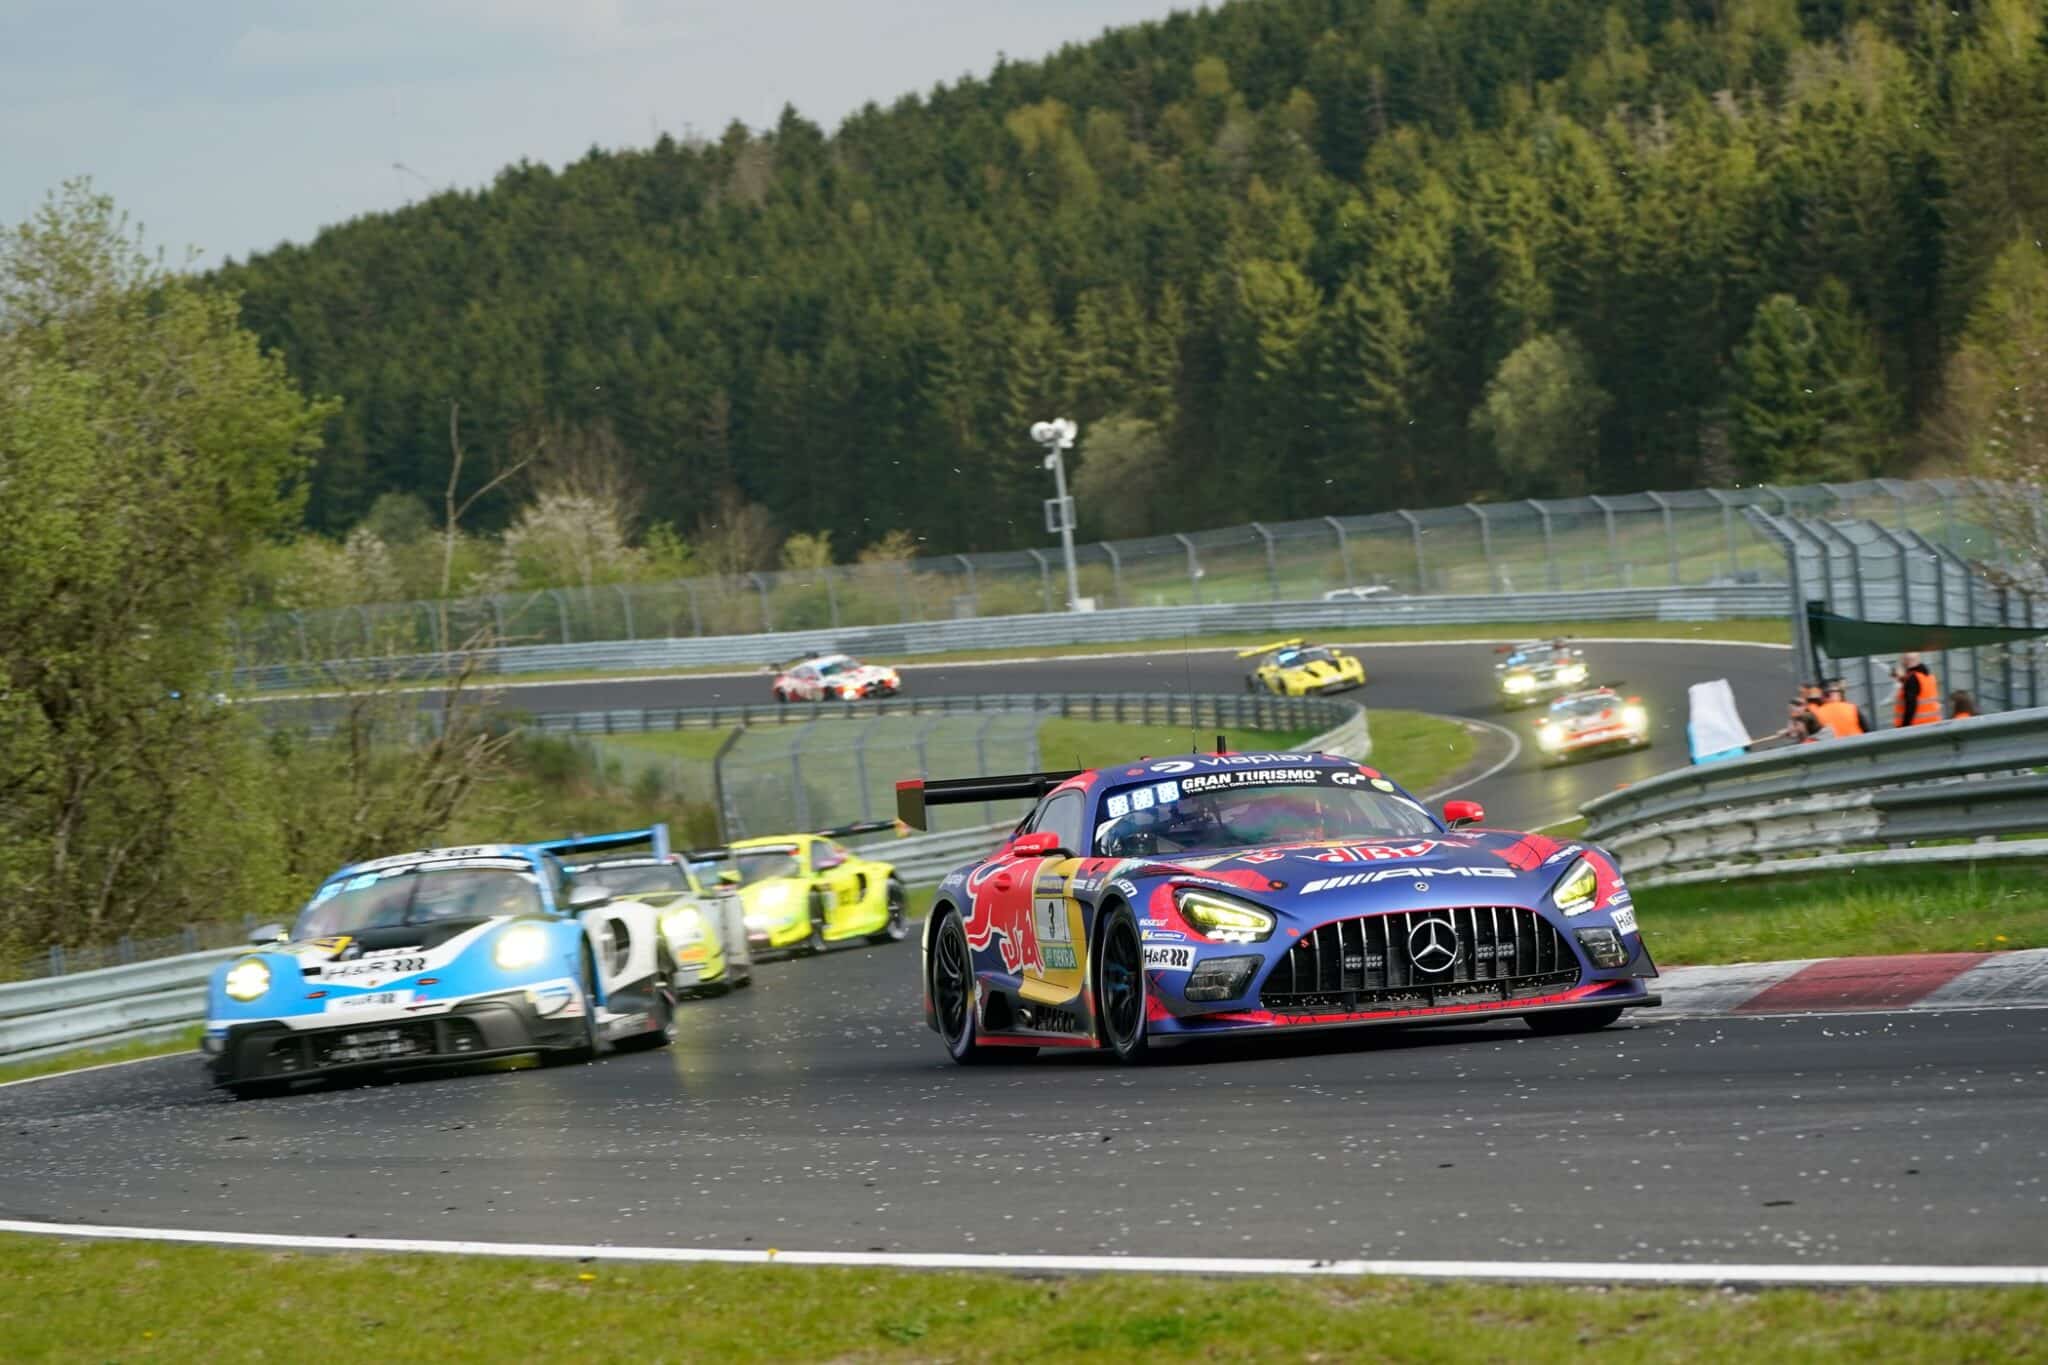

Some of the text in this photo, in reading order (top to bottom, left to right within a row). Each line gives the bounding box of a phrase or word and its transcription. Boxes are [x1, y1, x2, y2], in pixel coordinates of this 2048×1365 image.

[1182, 769, 1316, 790] GRAN TURISMO
[1372, 867, 1518, 882] AMG
[1144, 948, 1168, 963] H&R
